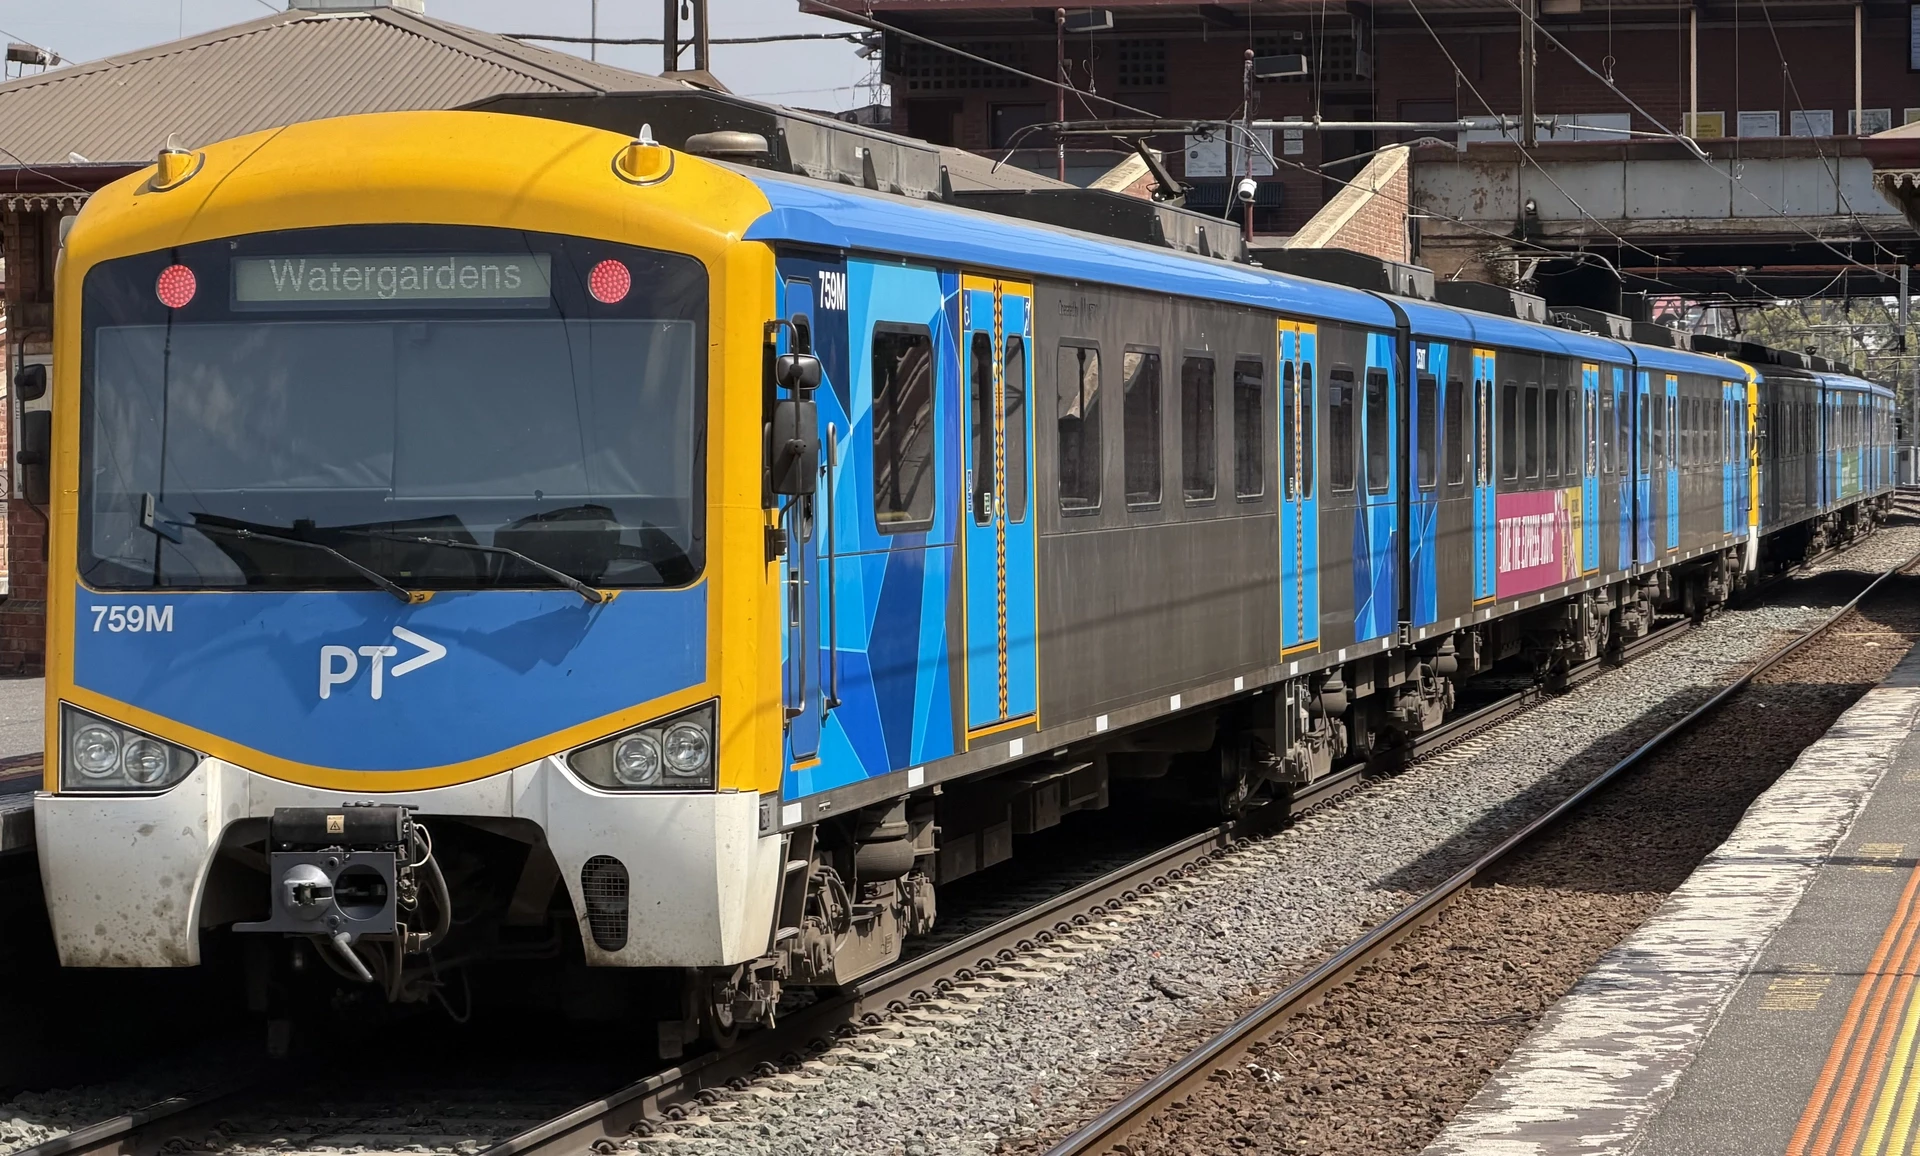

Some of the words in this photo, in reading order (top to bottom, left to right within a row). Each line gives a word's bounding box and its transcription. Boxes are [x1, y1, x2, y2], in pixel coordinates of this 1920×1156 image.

[268, 257, 522, 299] Watergardens
[818, 270, 846, 311] 759M
[90, 605, 174, 632] 759M
